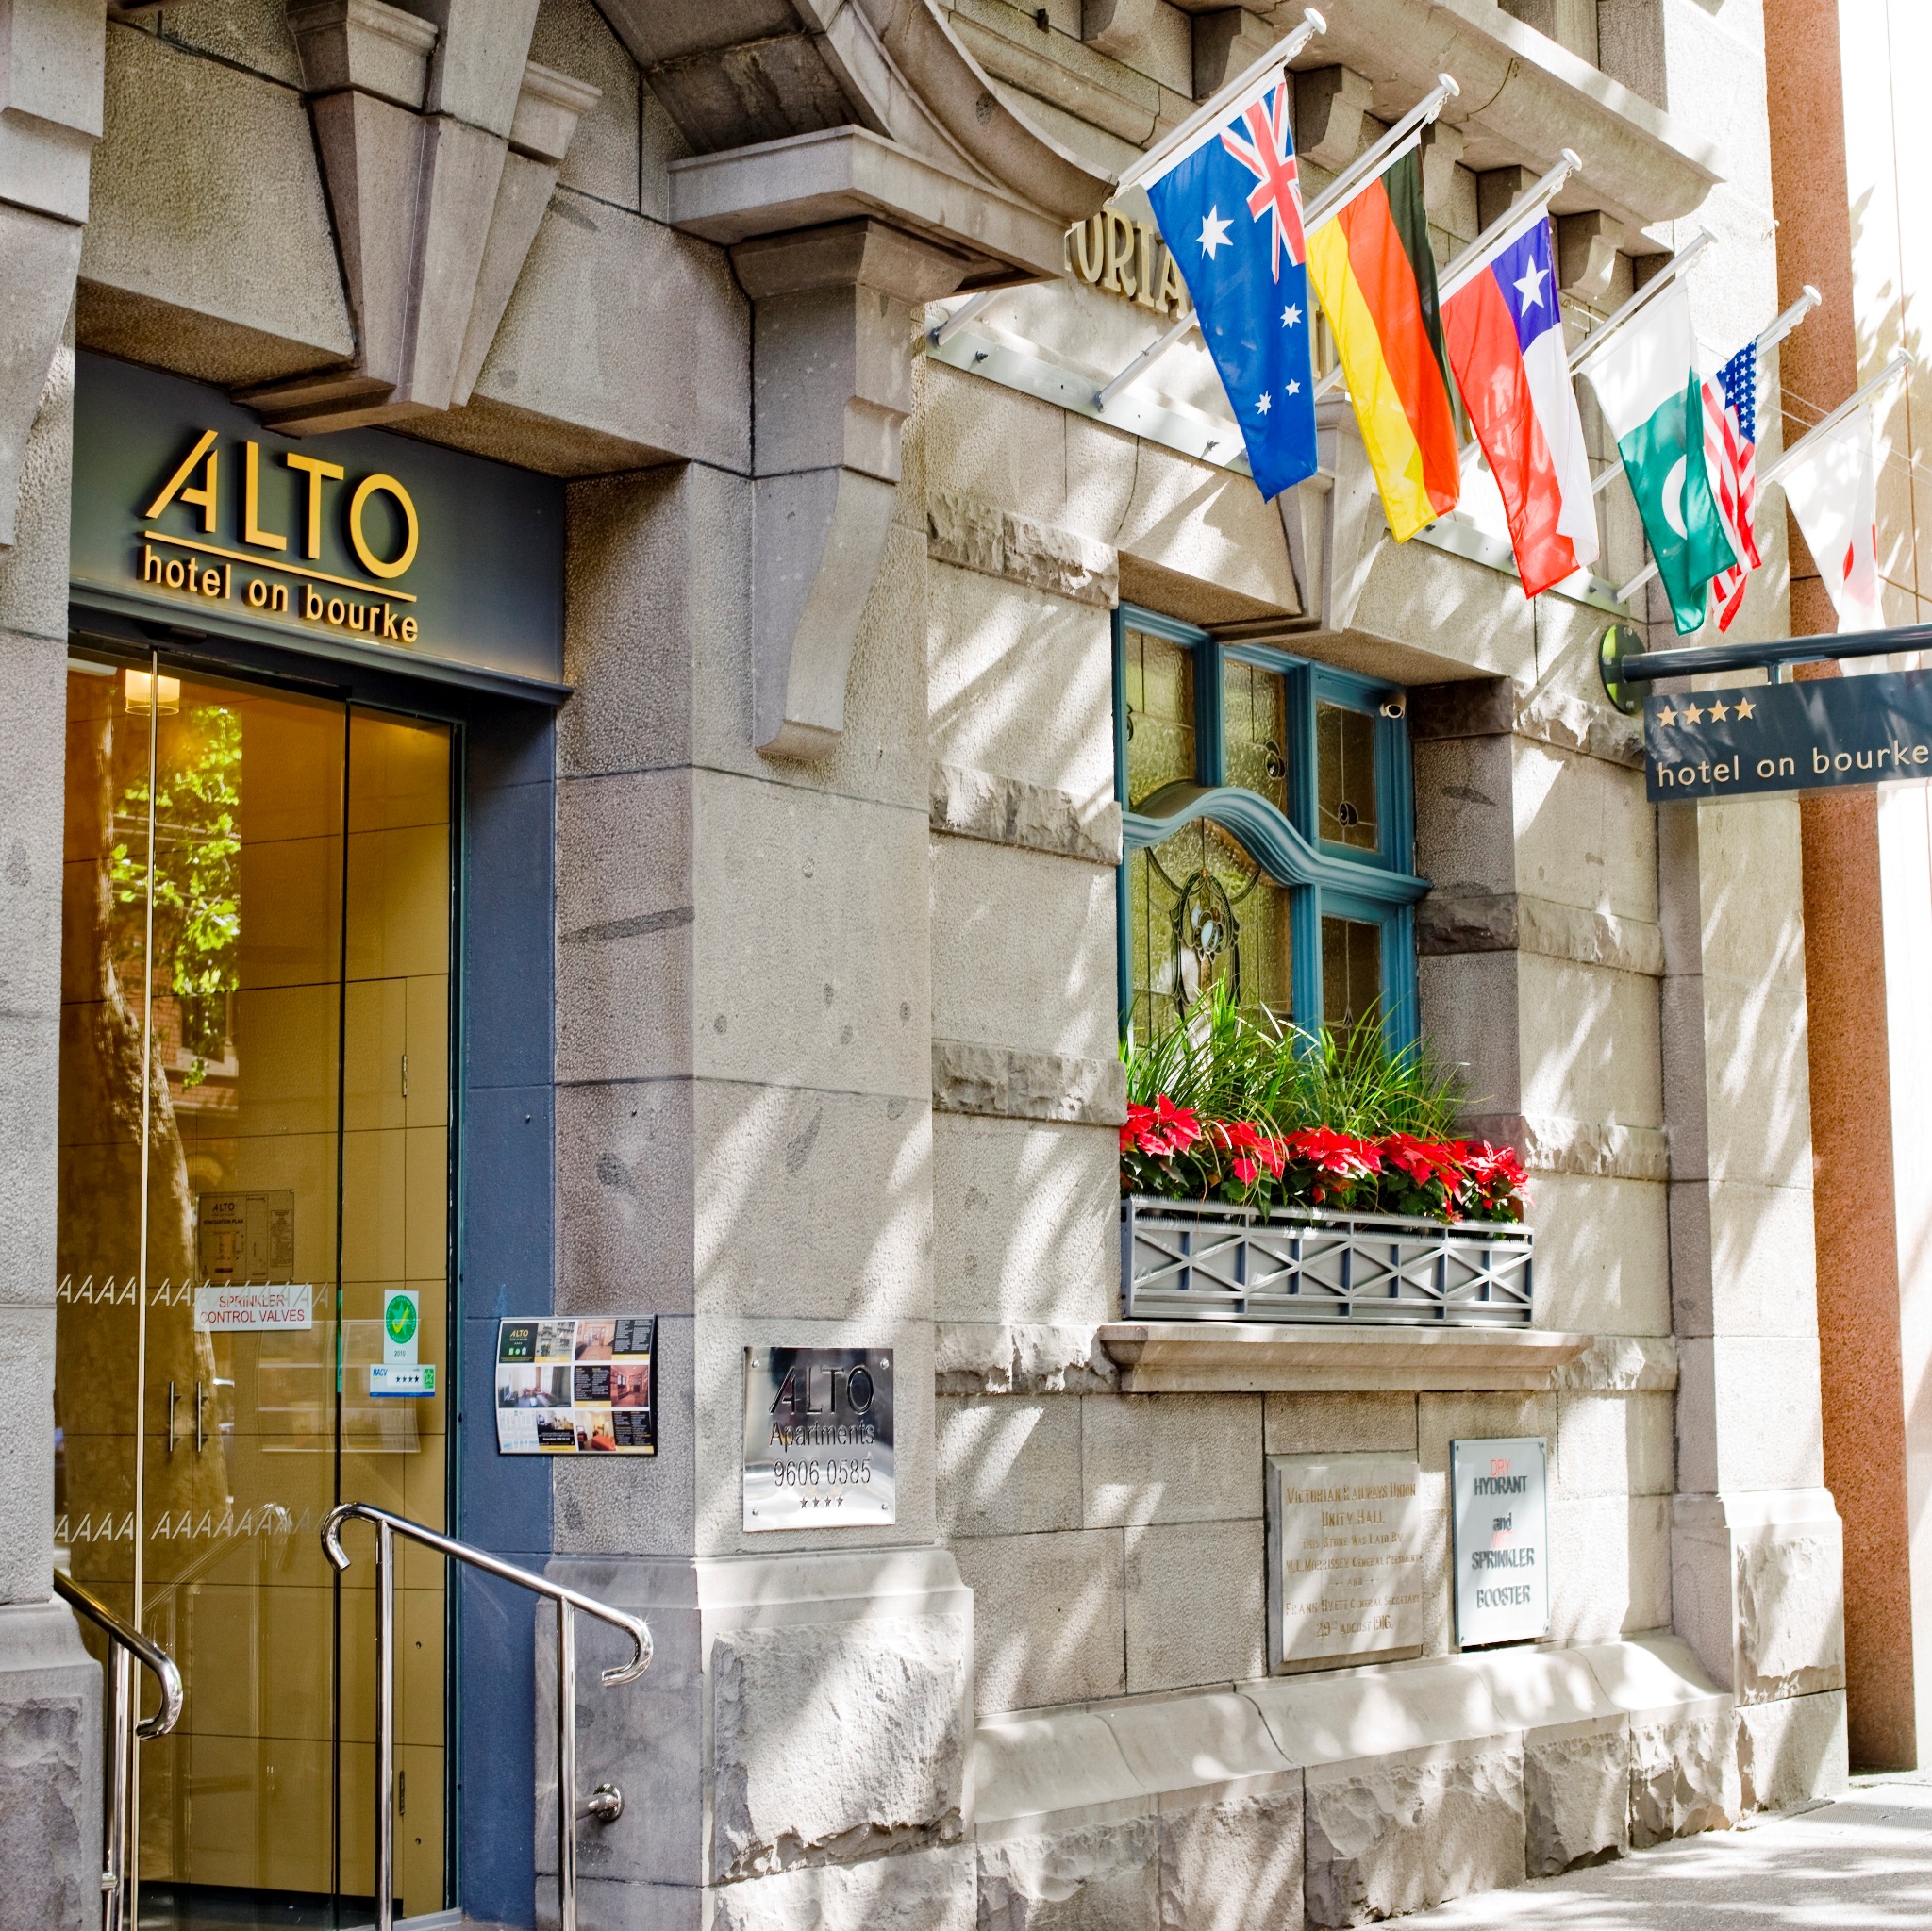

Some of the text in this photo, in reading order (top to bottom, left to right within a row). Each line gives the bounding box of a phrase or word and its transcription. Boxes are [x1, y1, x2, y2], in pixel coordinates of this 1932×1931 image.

[145, 430, 419, 579] ALTO
[143, 543, 419, 643] hotel on bourke
[1657, 740, 1930, 788] hotel on bourke
[212, 1202, 235, 1212] ALTO
[219, 1294, 285, 1308] SPRINKLER
[200, 1308, 305, 1323] CONTROL VALVES
[509, 1329, 529, 1338] ALTO
[373, 1368, 388, 1376] RACV
[769, 1364, 874, 1416] ALTO
[769, 1419, 875, 1454] Apartments
[774, 1457, 872, 1487] 9606 0585
[1491, 1458, 1511, 1477] DRY
[1474, 1475, 1527, 1496] HYDRANT
[1492, 1512, 1512, 1531] and
[1491, 1531, 1513, 1549] WET
[1471, 1548, 1535, 1570] SPRINKLER
[1476, 1584, 1531, 1609] BOOSTER
